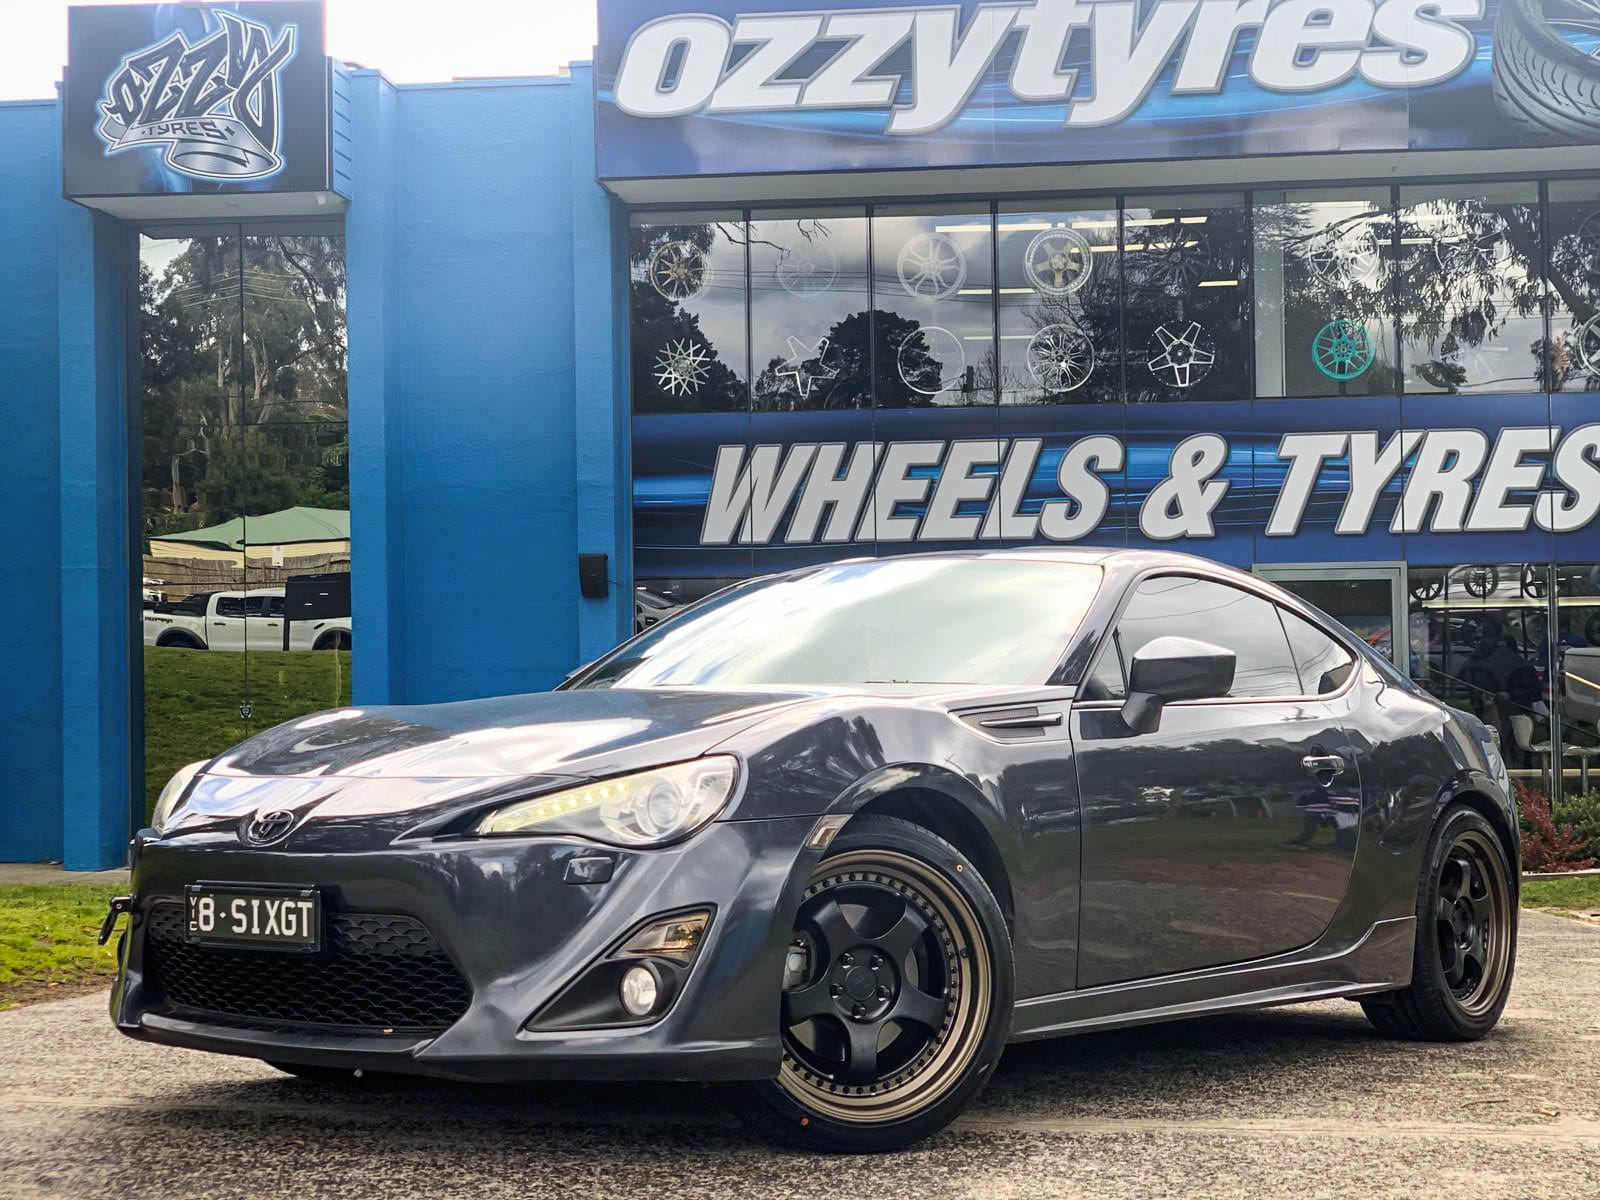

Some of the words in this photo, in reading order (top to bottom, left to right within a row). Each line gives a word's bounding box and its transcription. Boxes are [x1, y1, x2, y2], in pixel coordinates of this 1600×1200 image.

[614, 0, 1484, 135] ozzytyres
[146, 120, 230, 141] TYRES
[700, 435, 1125, 545] WHEELS
[1138, 432, 1231, 541] &
[1265, 423, 1600, 537] TYRES
